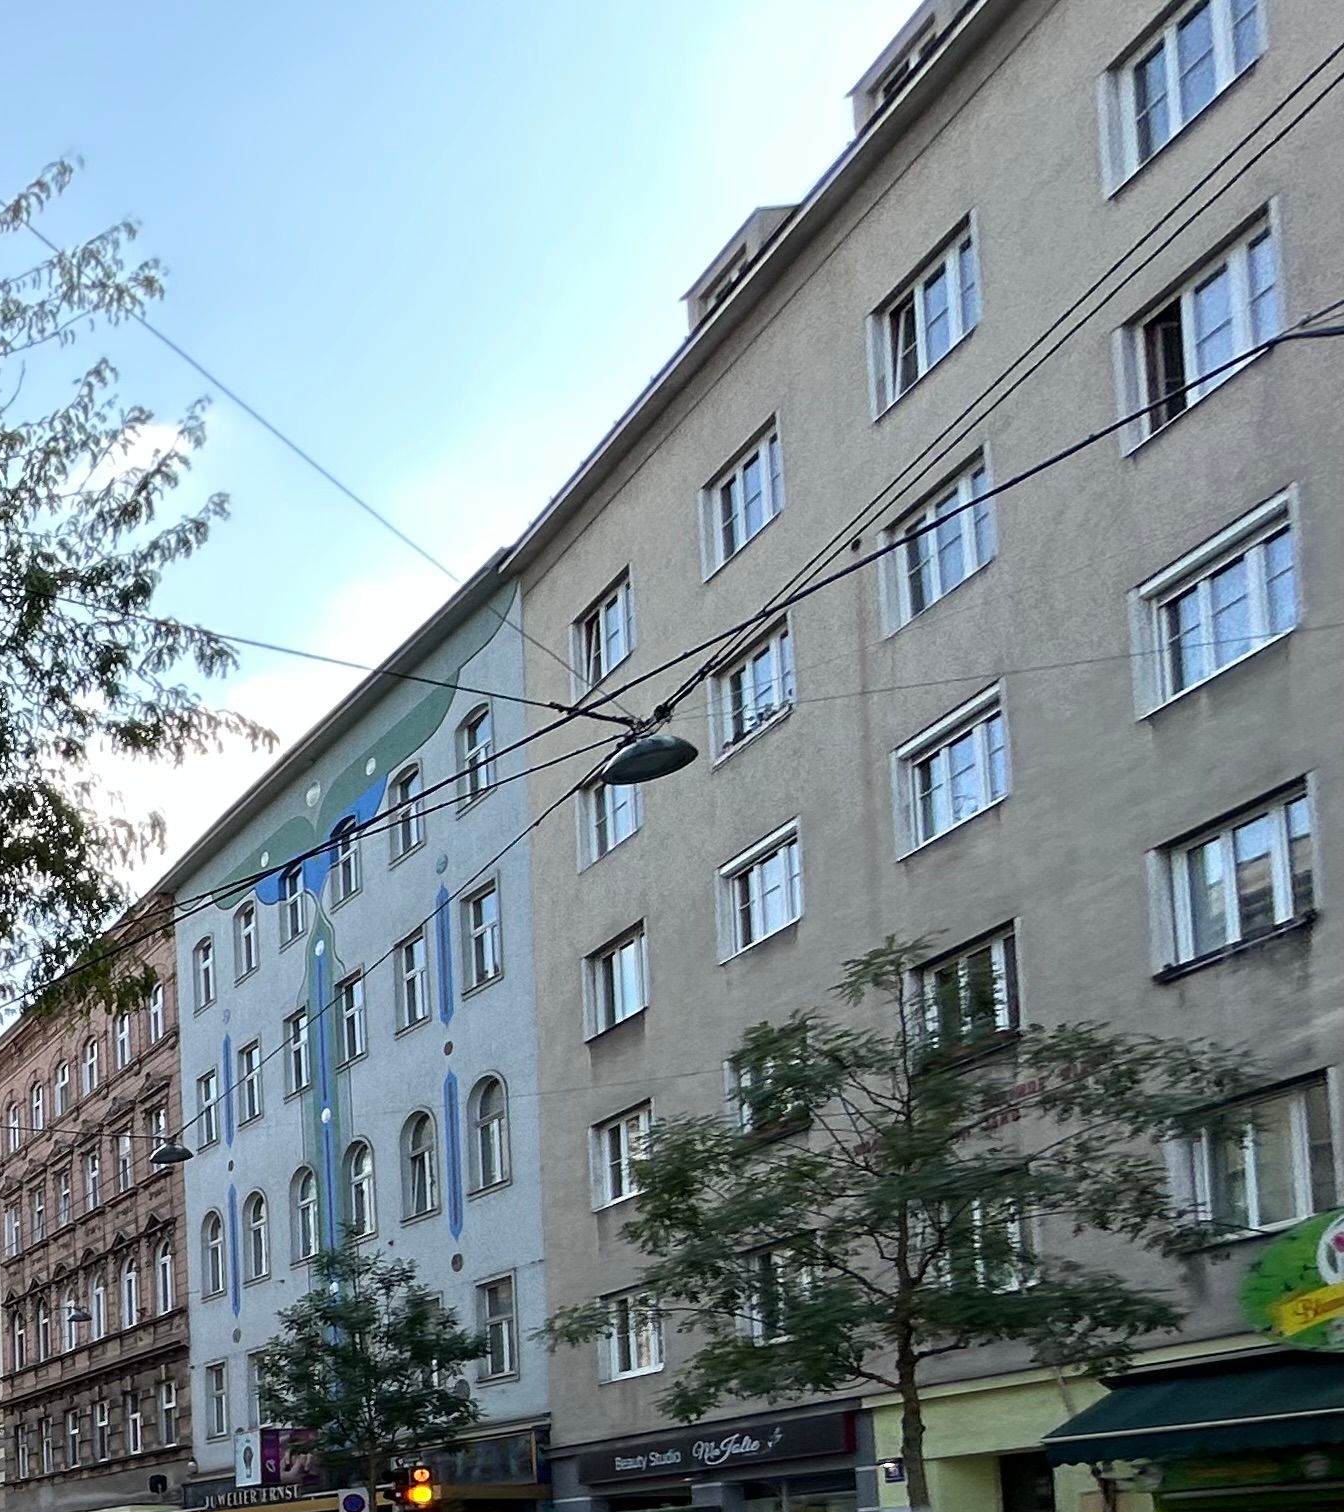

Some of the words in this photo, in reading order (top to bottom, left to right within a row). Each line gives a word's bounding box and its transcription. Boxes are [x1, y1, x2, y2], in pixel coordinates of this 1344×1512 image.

[615, 1455, 647, 1470] Beauty
[649, 1450, 681, 1467] Studio
[205, 1490, 257, 1509] JUWELIER
[262, 1484, 302, 1502] ERNST
